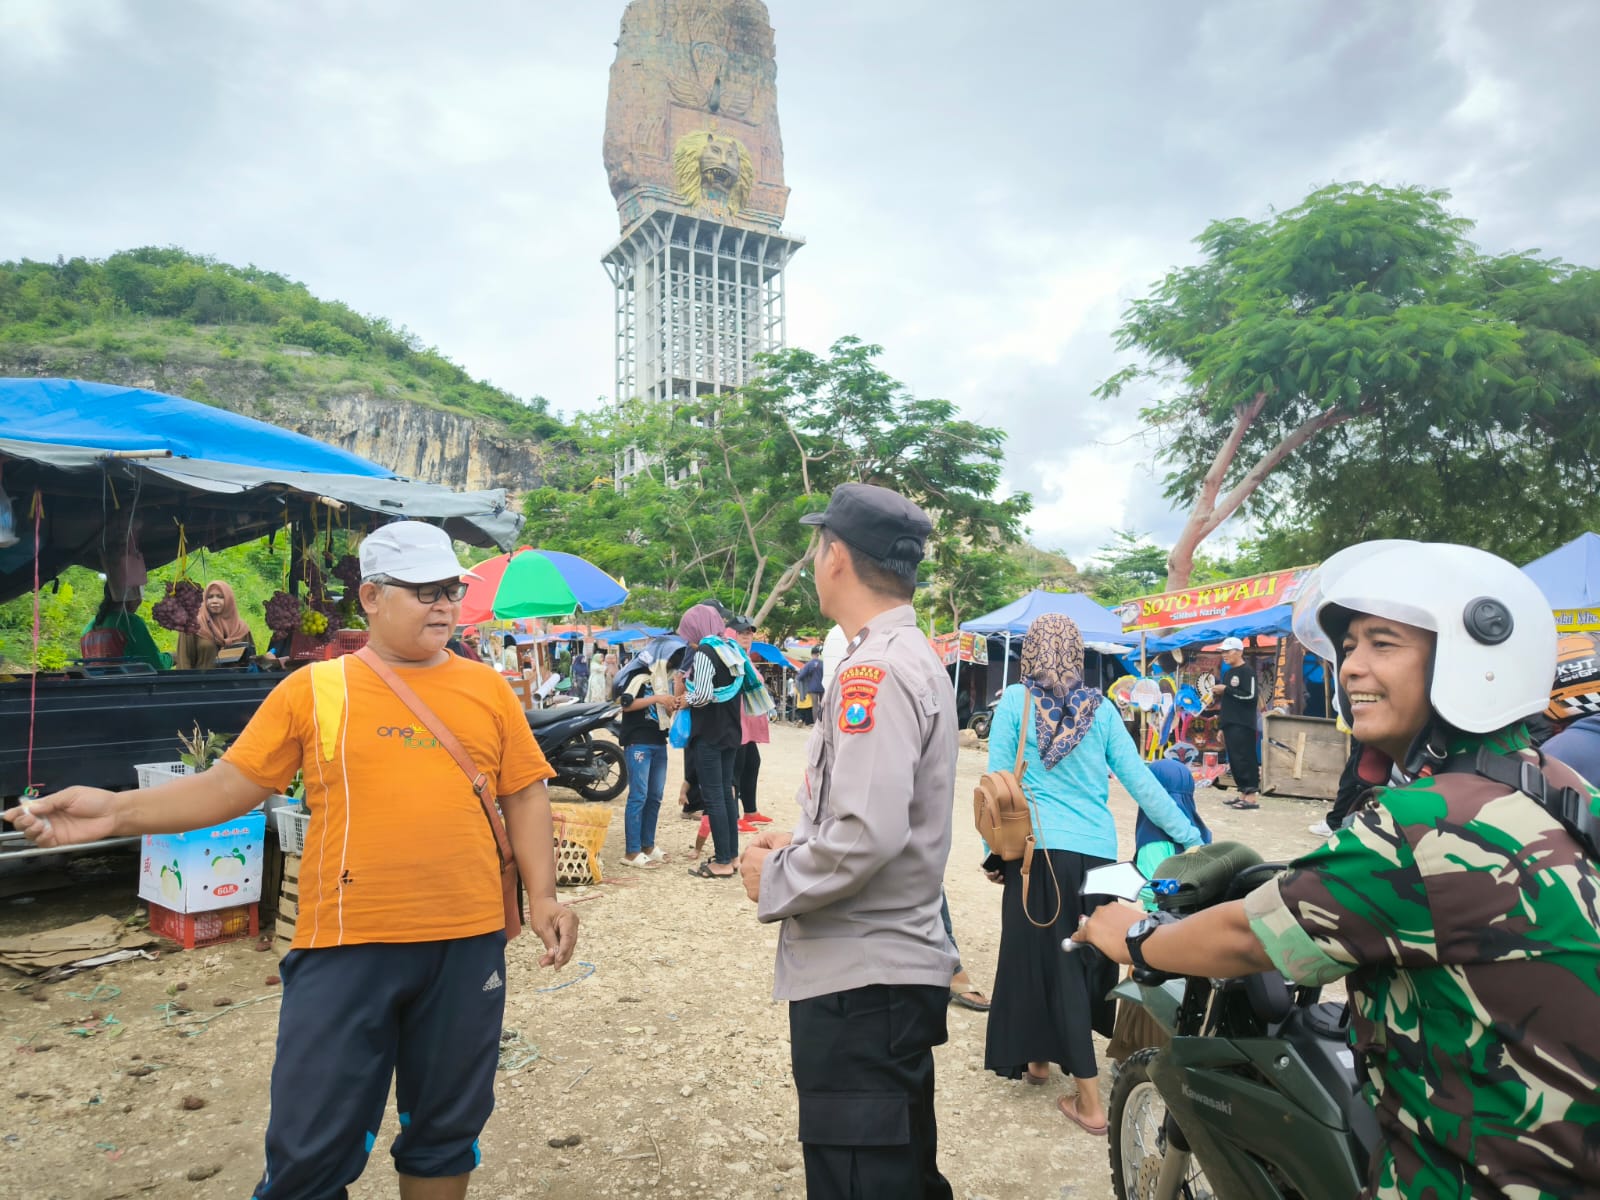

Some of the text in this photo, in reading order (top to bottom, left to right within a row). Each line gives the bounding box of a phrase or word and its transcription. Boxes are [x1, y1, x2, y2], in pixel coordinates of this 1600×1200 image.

[1142, 577, 1278, 617] SOTO KWALI
[1557, 658, 1595, 676] KYT
[376, 726, 414, 738] one
[1181, 1083, 1232, 1116] Kawasaki
